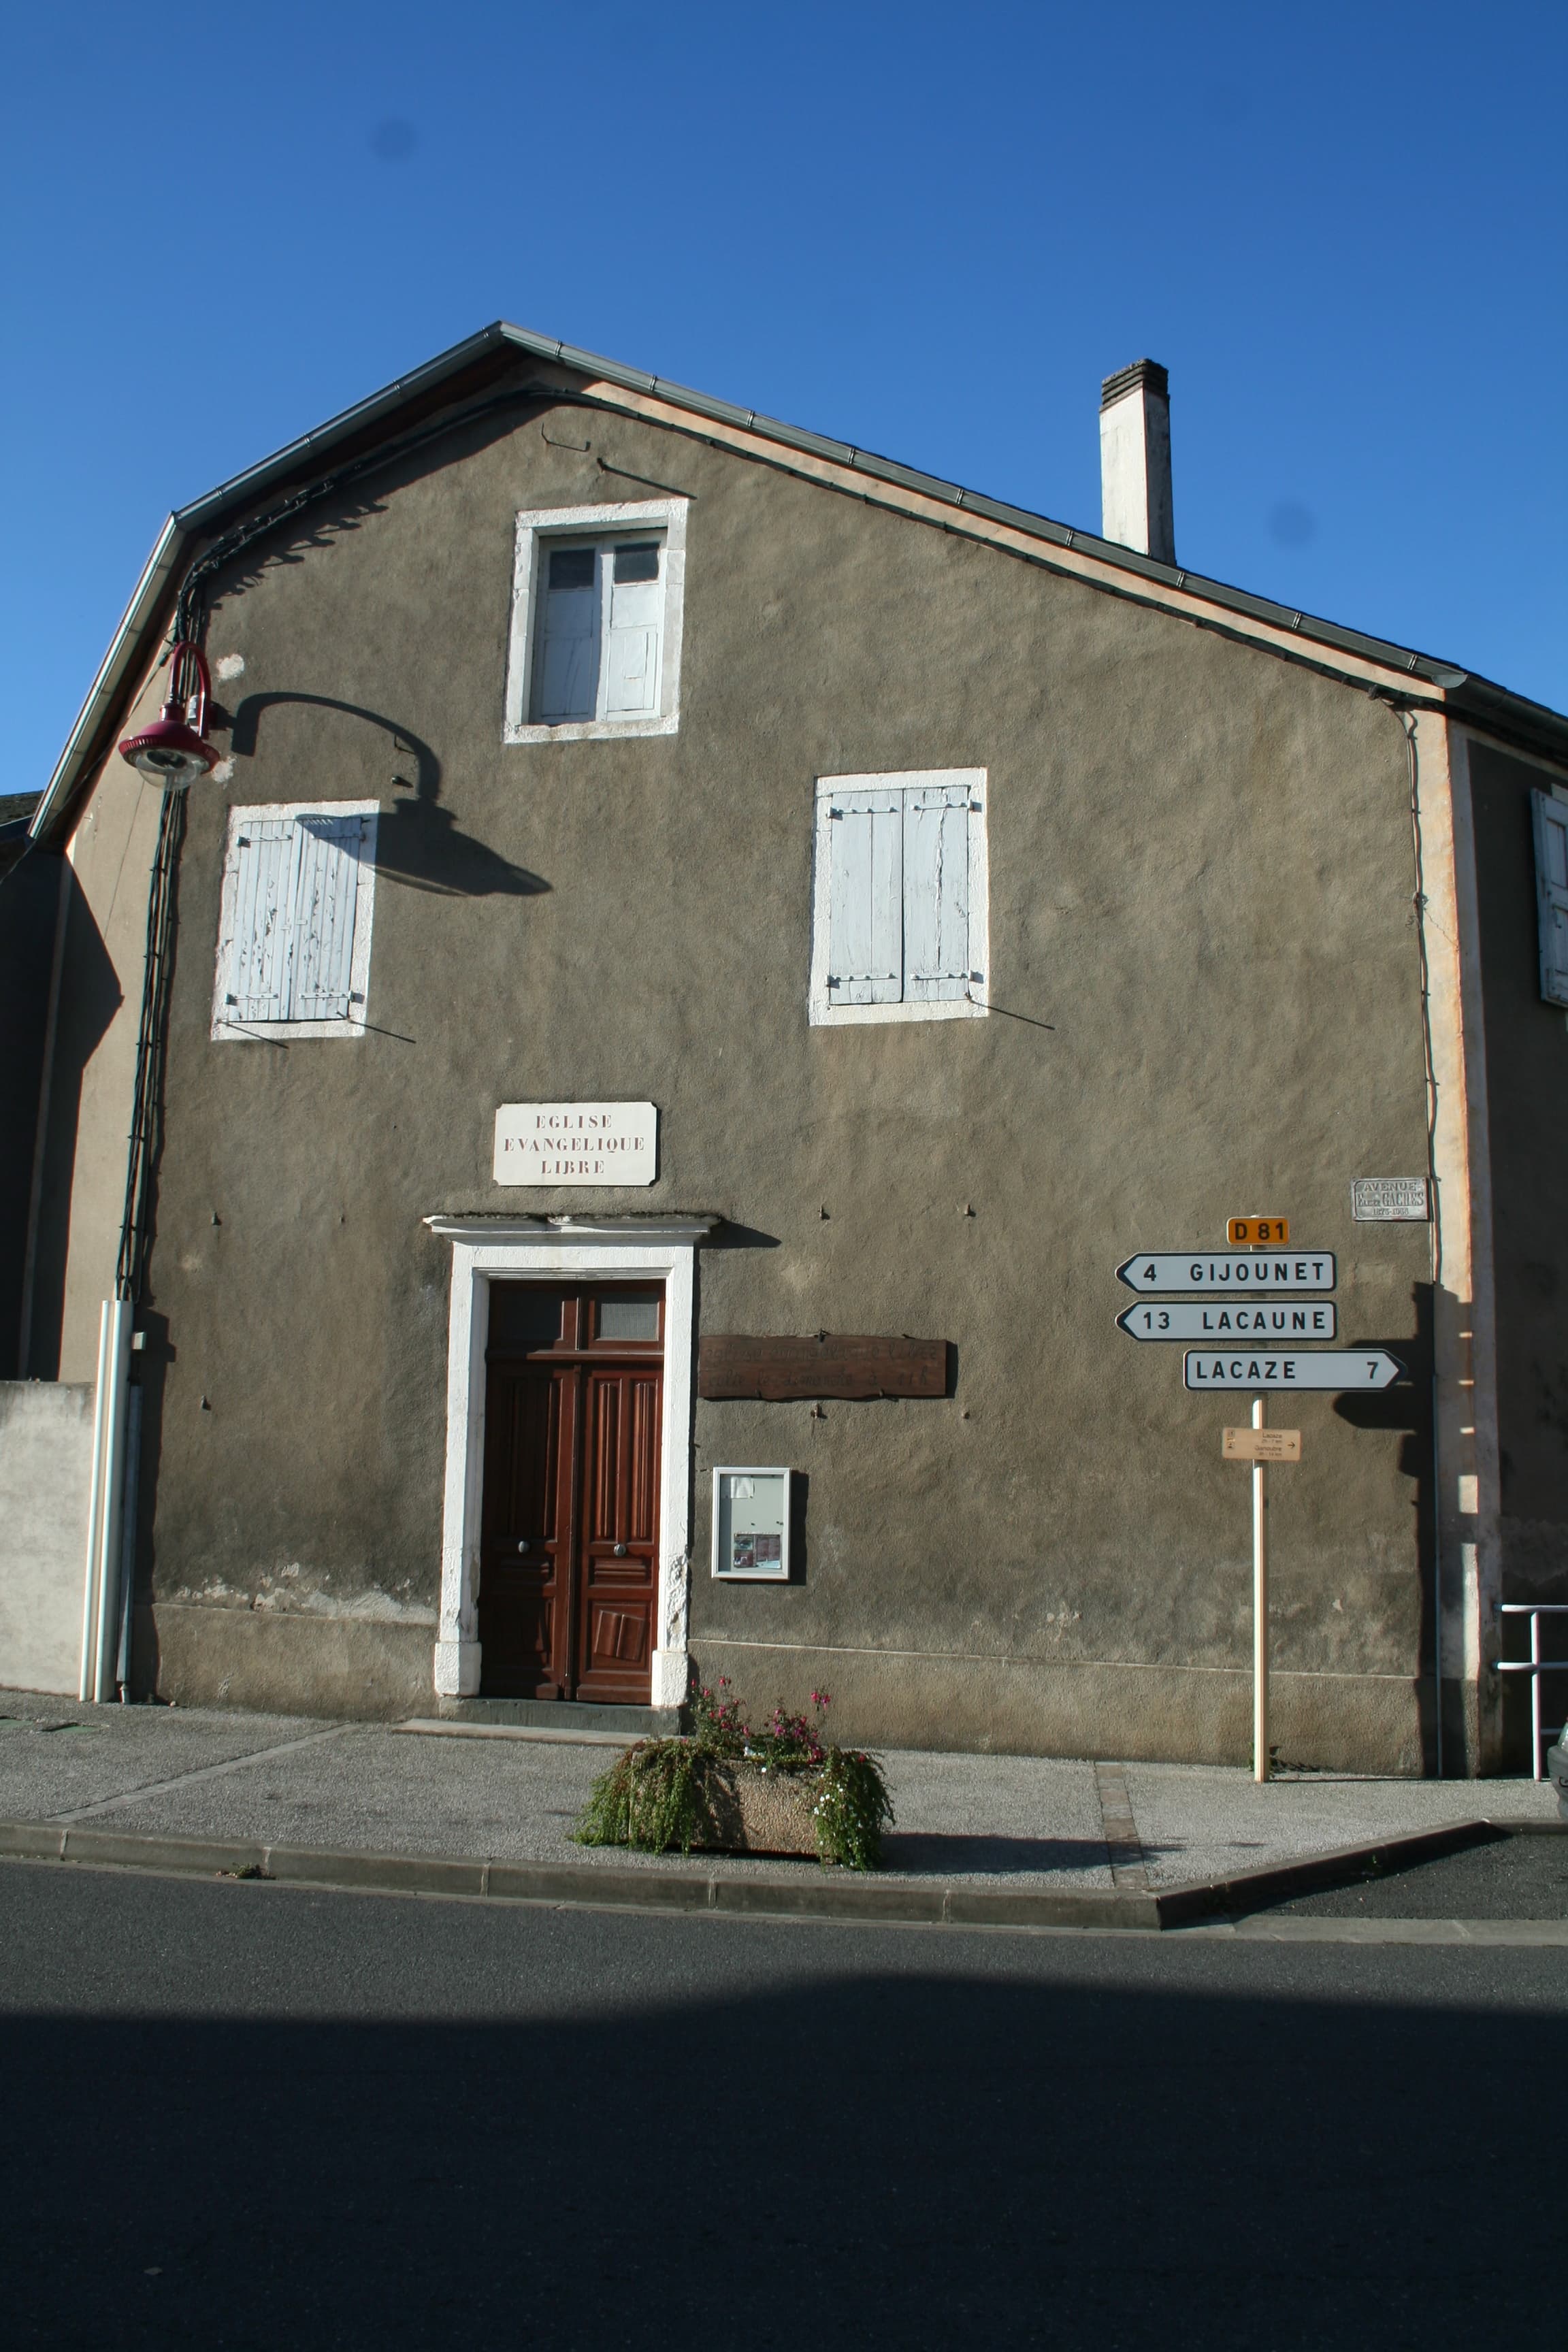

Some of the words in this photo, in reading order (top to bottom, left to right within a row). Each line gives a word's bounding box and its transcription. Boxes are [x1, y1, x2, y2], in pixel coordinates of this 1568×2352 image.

[536, 1114, 612, 1128] EGLISE
[504, 1137, 644, 1153] EVANGELIQUE
[542, 1160, 604, 1174] LIBRE
[1364, 1181, 1417, 1192] AVENUE
[1234, 1223, 1247, 1241] D
[1258, 1222, 1285, 1241] 81
[1143, 1263, 1157, 1281] 4
[1190, 1262, 1324, 1281] GIJOUNET
[1143, 1311, 1170, 1330] 13
[1203, 1311, 1325, 1330] LACAUNE
[1196, 1360, 1296, 1380] LACAZE
[1367, 1362, 1379, 1379] 7
